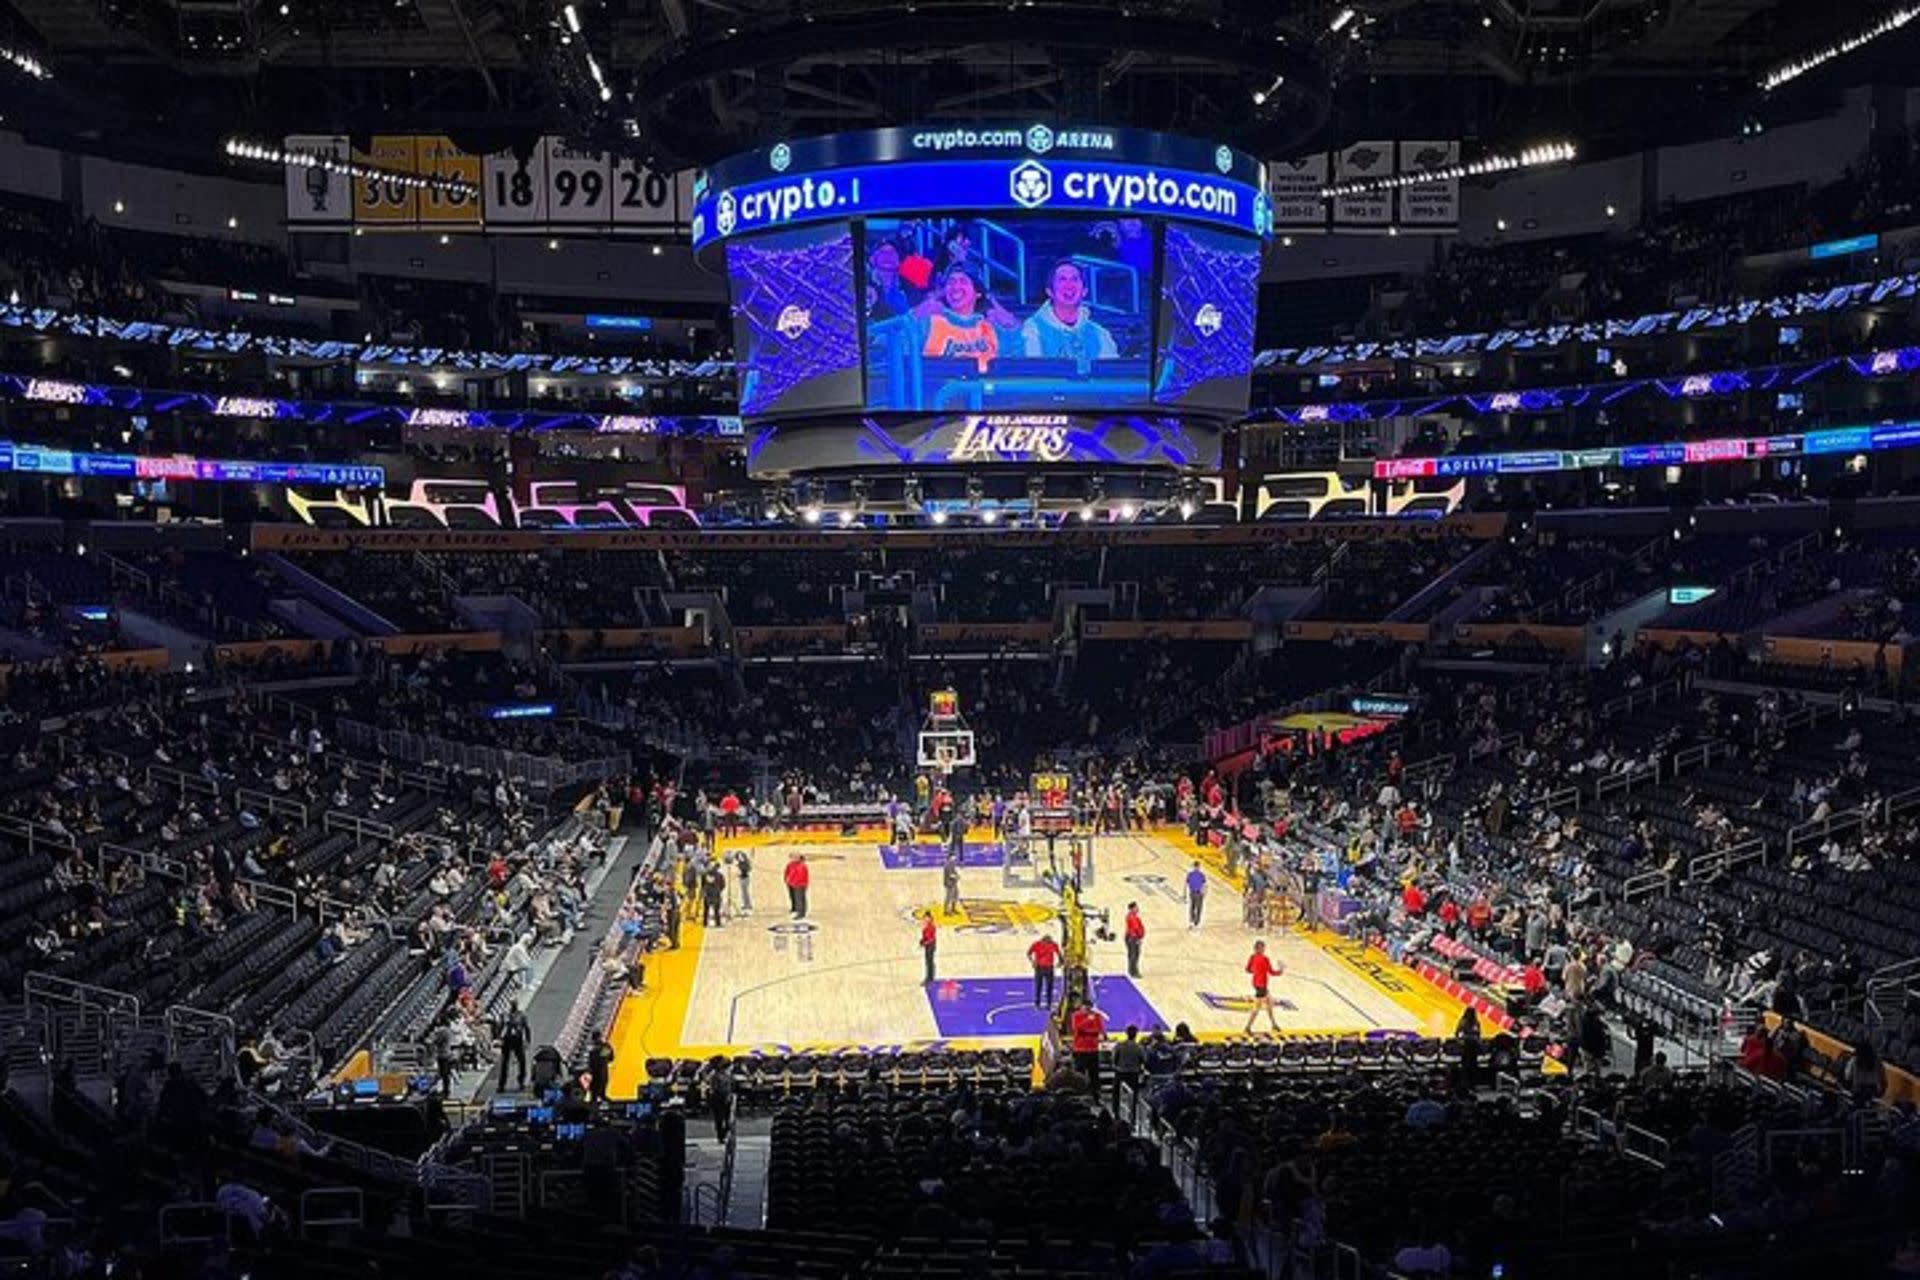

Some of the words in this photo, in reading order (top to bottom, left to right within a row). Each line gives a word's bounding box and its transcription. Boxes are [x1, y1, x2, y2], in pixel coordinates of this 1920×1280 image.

[913, 128, 1022, 150] crypto.com
[1056, 132, 1113, 149] ARENA
[496, 170, 533, 207] 18
[555, 170, 603, 206] 99
[621, 172, 667, 208] 20
[1063, 169, 1236, 217] crypto.com
[338, 467, 380, 483] DELTA
[1453, 459, 1495, 472] DELTA
